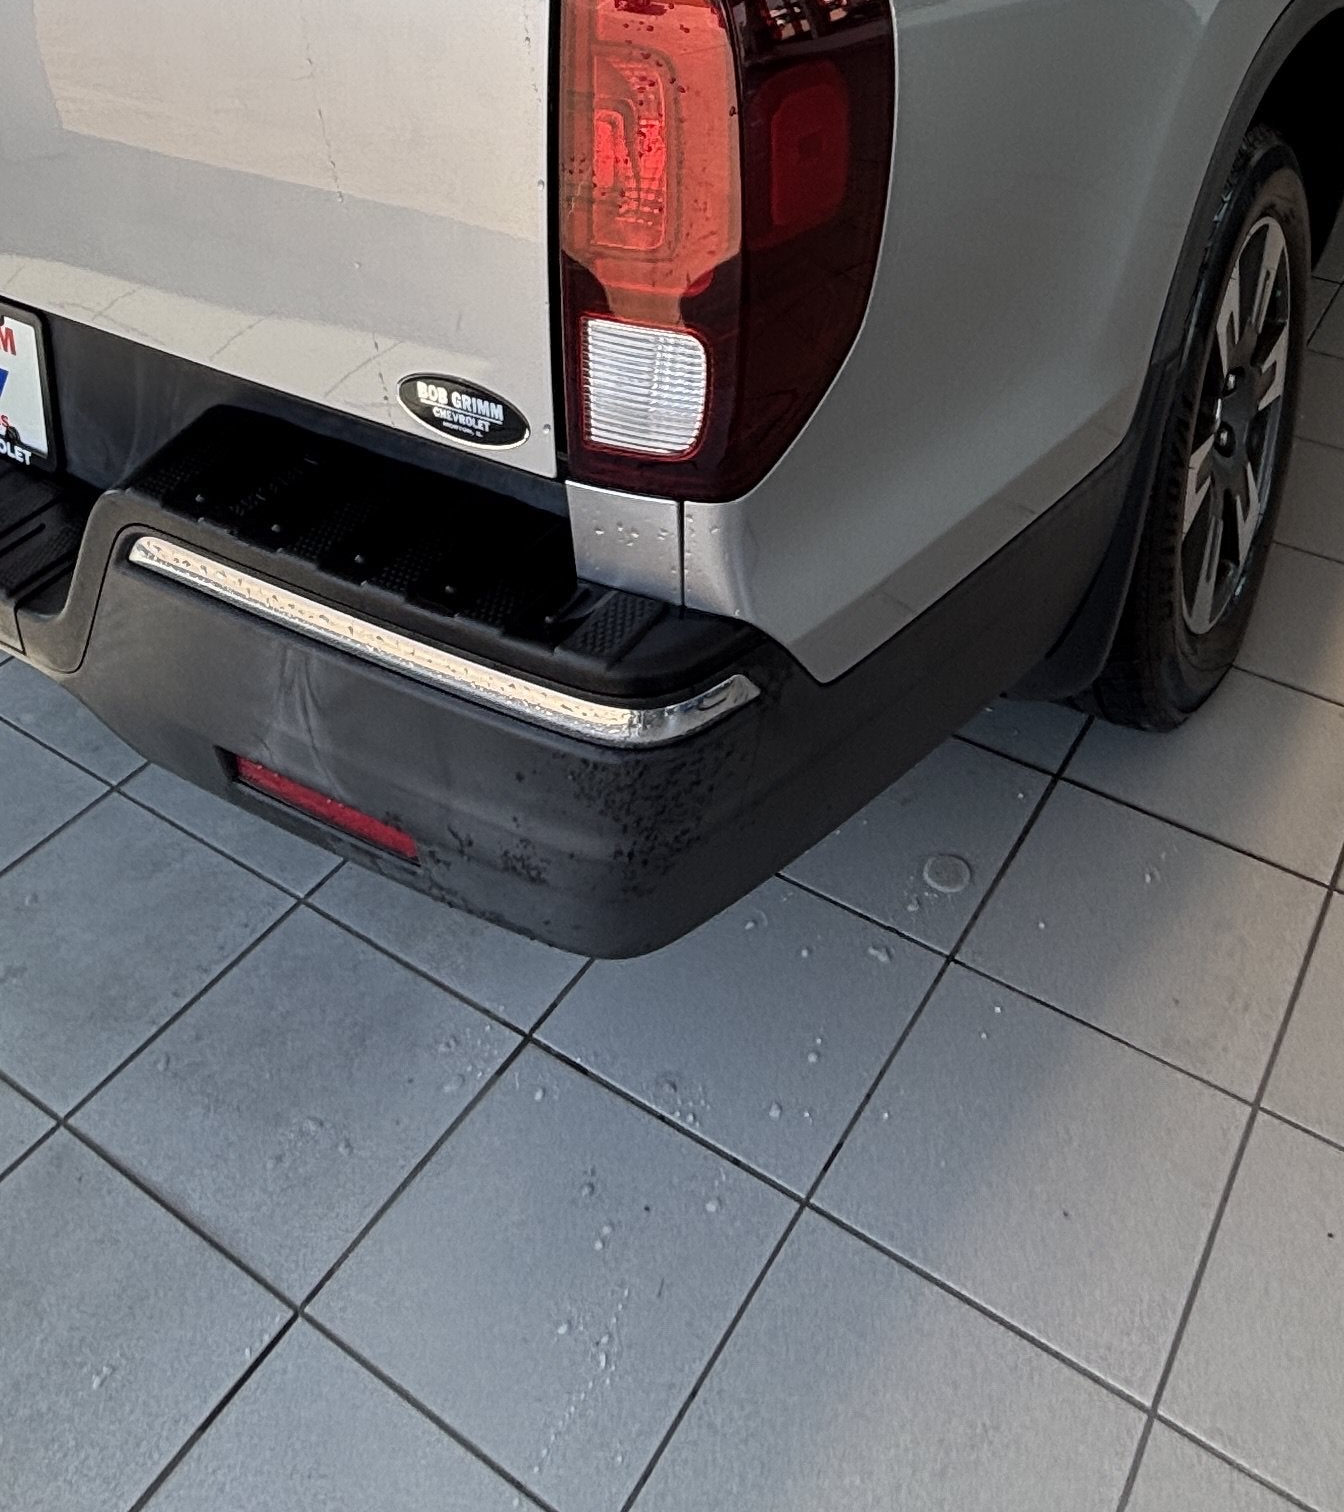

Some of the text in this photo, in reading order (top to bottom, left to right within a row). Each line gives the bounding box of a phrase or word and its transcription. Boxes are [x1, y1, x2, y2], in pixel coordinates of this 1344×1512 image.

[416, 381, 504, 421] BOB GRIMM
[432, 407, 490, 432] CHEVROLET
